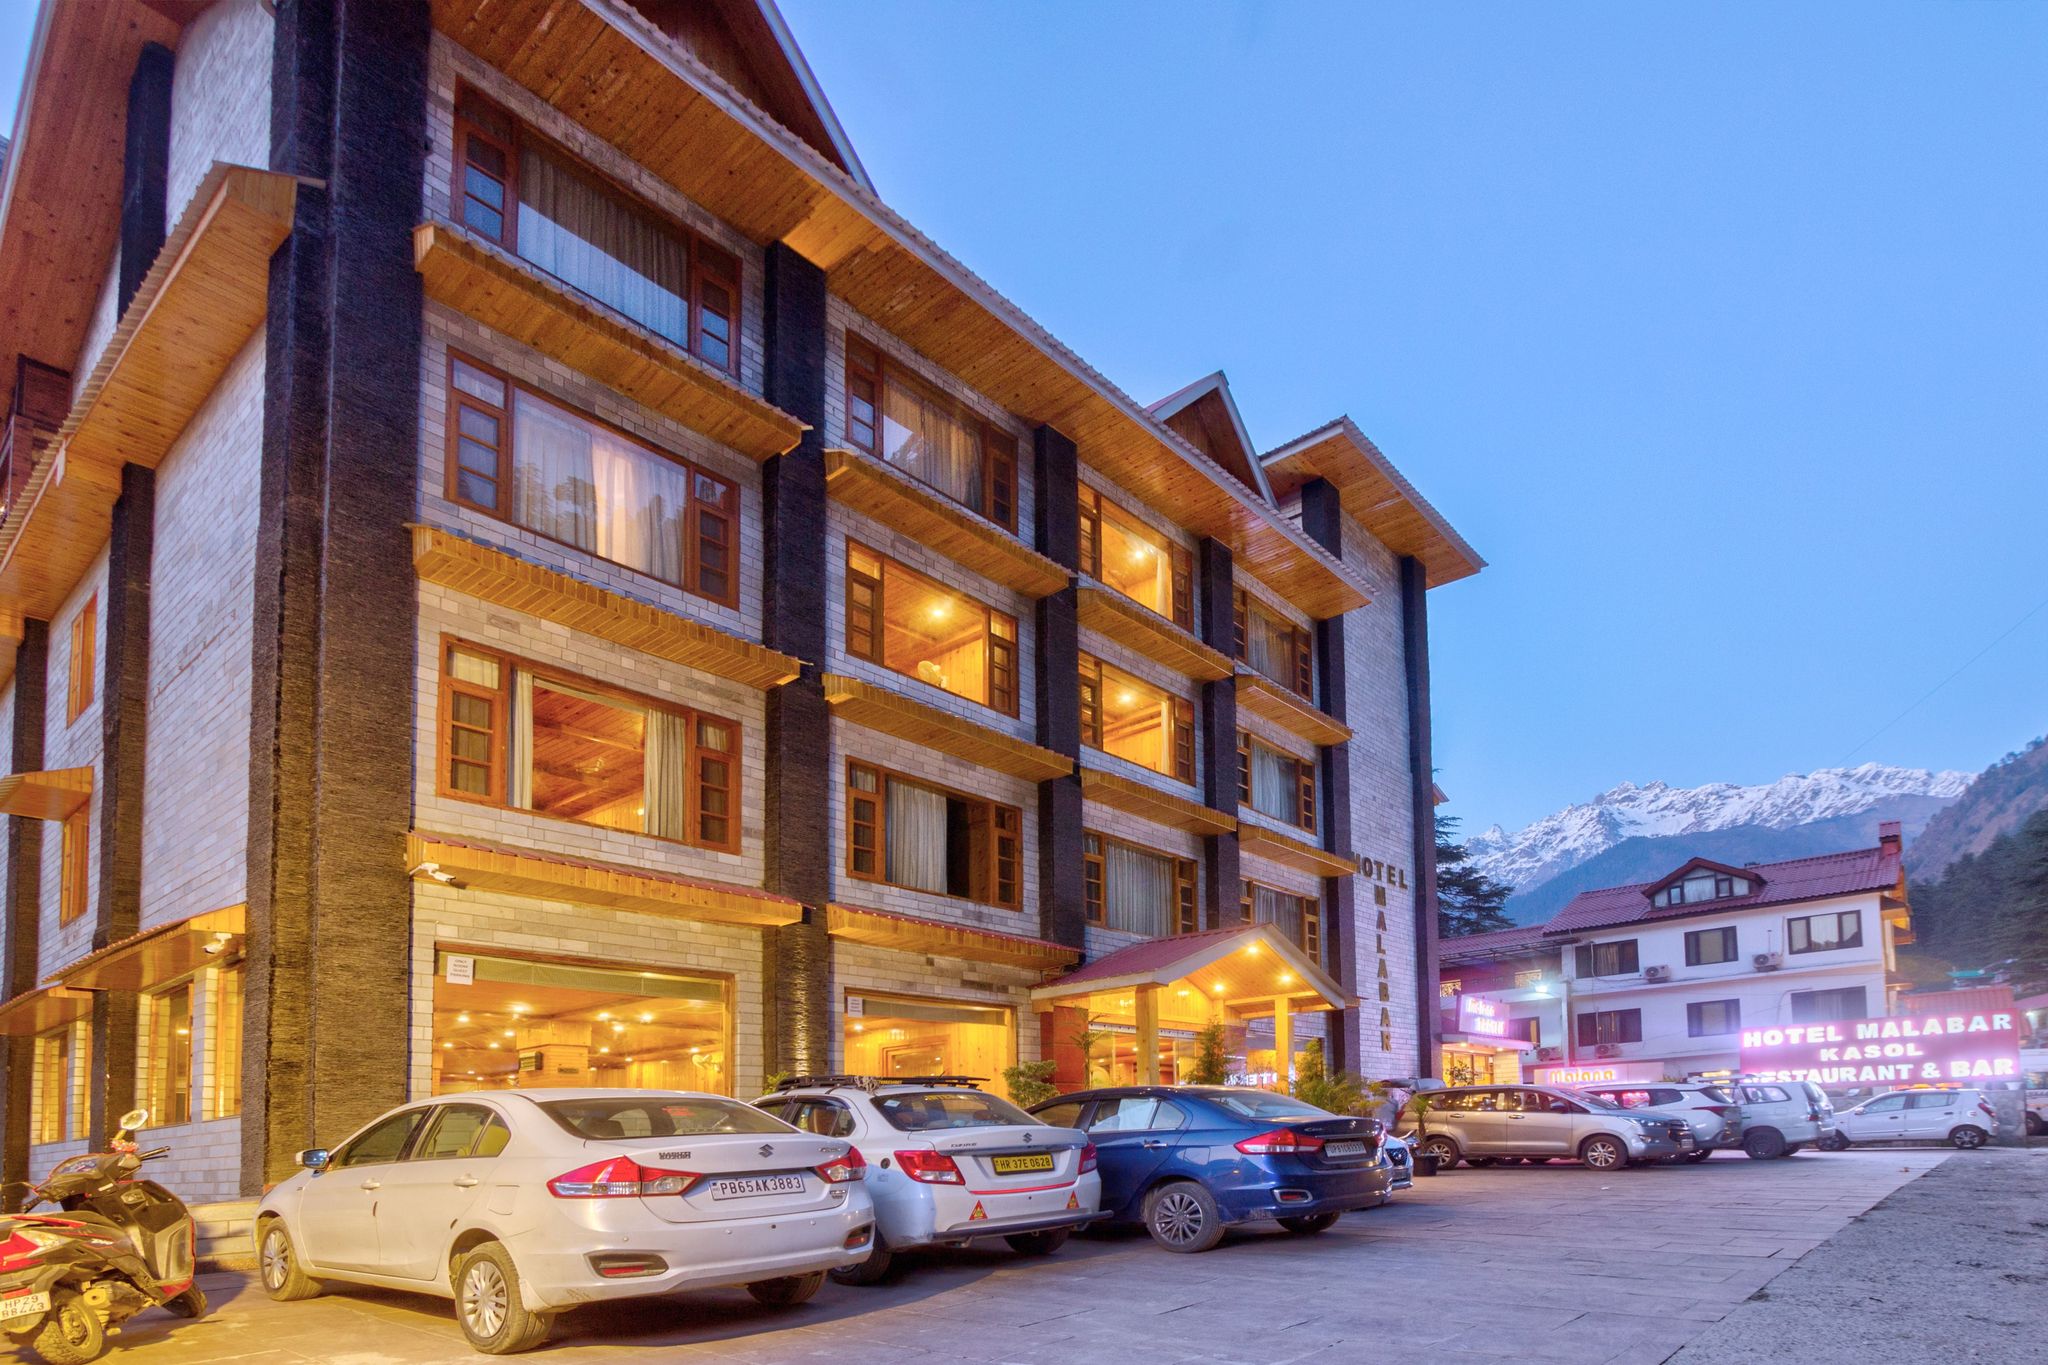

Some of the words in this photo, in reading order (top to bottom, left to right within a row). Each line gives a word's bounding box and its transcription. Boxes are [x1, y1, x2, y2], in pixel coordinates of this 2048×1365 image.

[1374, 884, 1392, 1053] MALABAR
[1743, 1025, 1843, 1048] HOTEL
[1856, 1013, 2013, 1040] MALABAR
[1820, 1043, 1924, 1062] KASOL
[1921, 1062, 1941, 1079] &
[1950, 1058, 2014, 1078] BAR
[1000, 1159, 1010, 1170] HR
[1013, 1158, 1029, 1169] 37E
[720, 1177, 801, 1195] PB65AK3883
